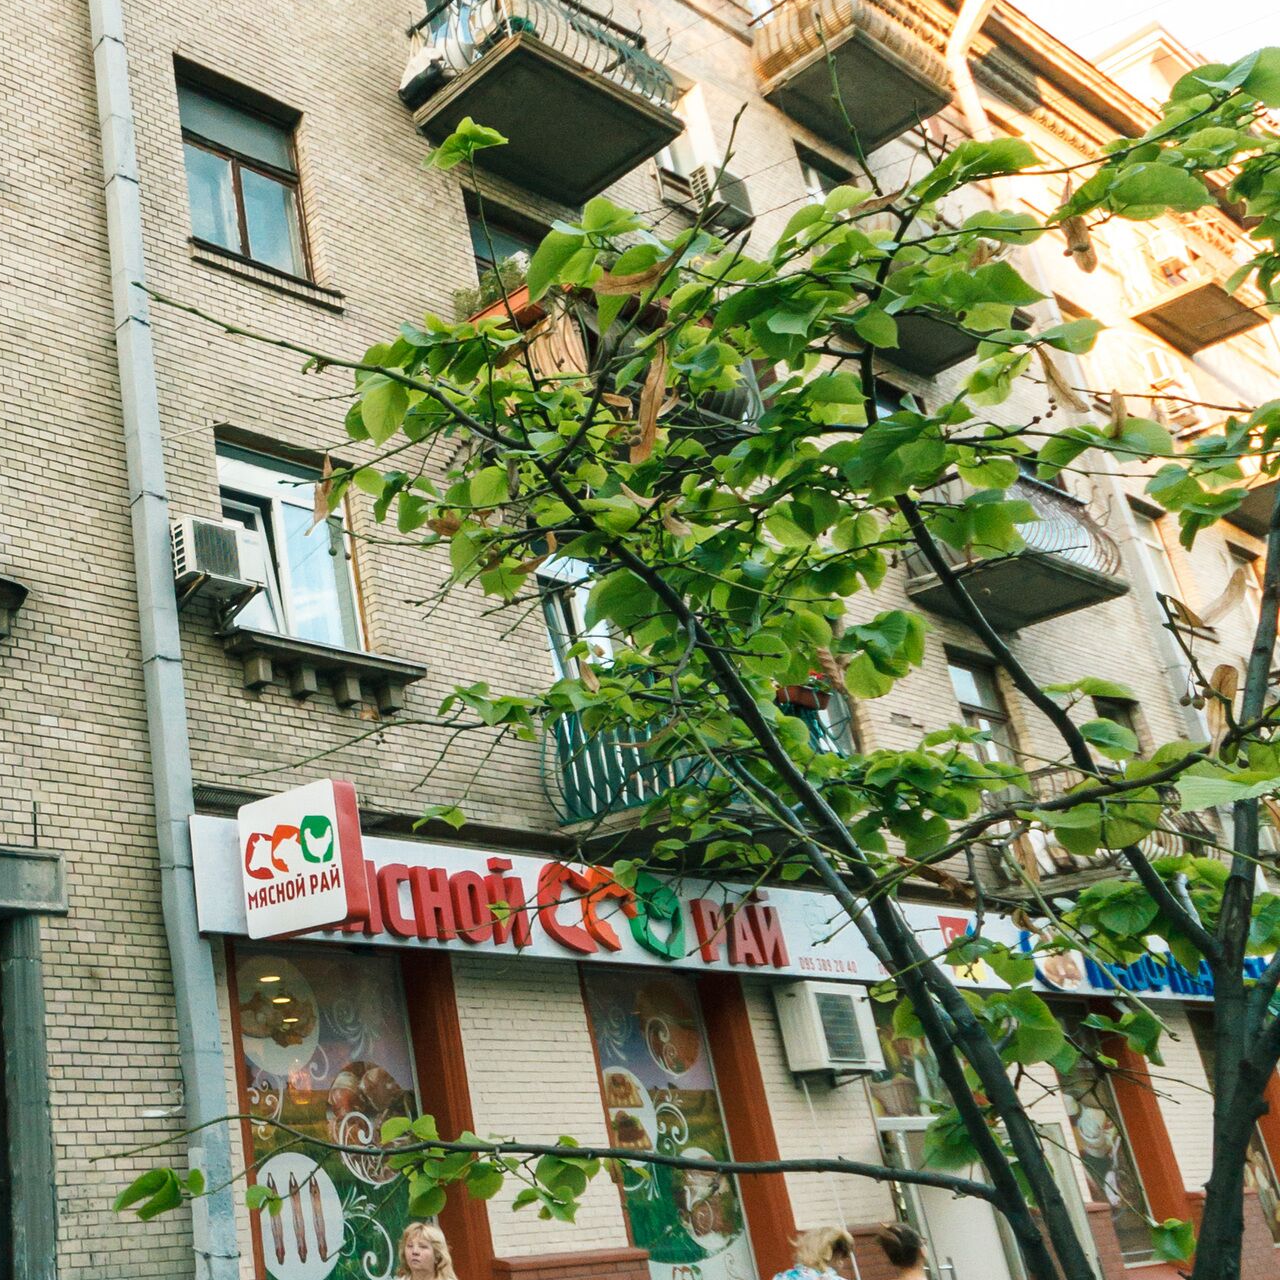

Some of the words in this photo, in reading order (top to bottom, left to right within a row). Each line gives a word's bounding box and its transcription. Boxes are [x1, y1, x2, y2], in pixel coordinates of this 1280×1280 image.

[247, 873, 306, 910] МЯСНОЙ
[309, 863, 341, 895] РАЙ
[688, 888, 791, 969] РАЙ
